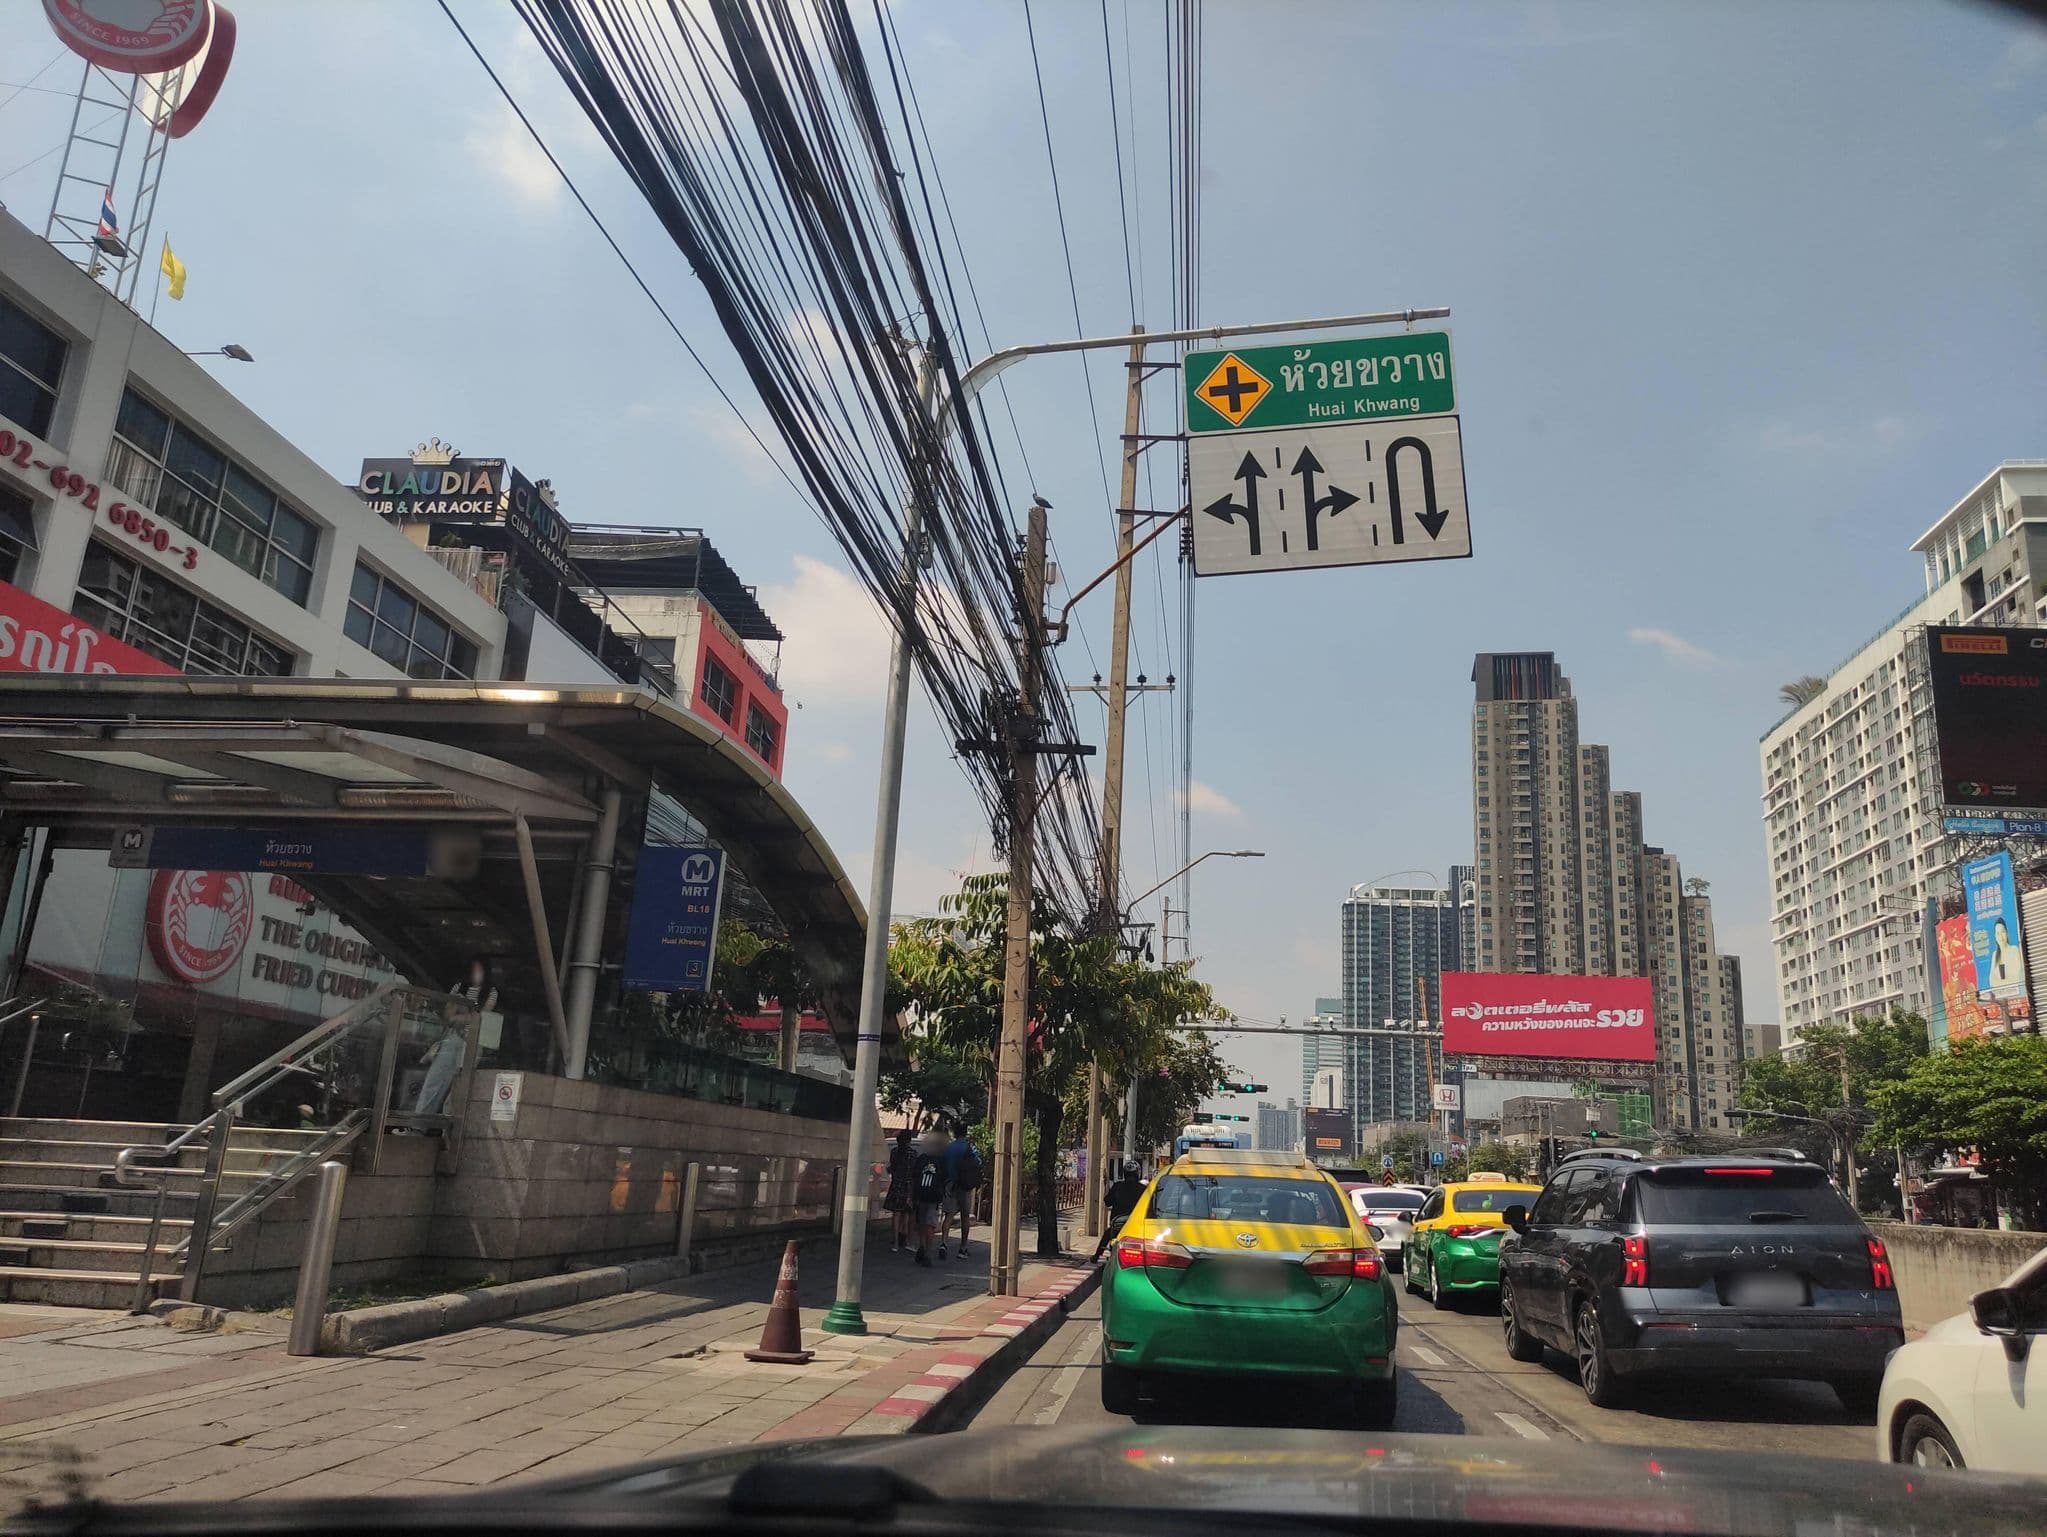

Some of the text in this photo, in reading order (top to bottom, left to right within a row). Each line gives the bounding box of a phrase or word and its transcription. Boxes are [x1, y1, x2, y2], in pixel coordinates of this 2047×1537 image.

[69, 12, 150, 46] SINCE 1969
[1280, 349, 1446, 392] ห้วยขวาง
[1308, 396, 1420, 417] Huai Khwang
[361, 471, 494, 495] CLAUDIA
[0, 431, 198, 569] 02-692 6850-3
[366, 500, 493, 514] LUB & KARAOKE
[515, 487, 569, 553] CLAUDIA
[511, 514, 529, 538] CLUB
[536, 536, 570, 577] KARAOKE
[266, 840, 312, 854] ห้วยขวาง
[681, 886, 710, 897] MRT
[687, 904, 710, 913] BL18
[261, 915, 303, 949] THE
[667, 921, 708, 935] ห้วยขวาง
[179, 945, 202, 967] SINCE
[252, 953, 314, 988] FRIED
[1731, 1245, 1795, 1255] AION
